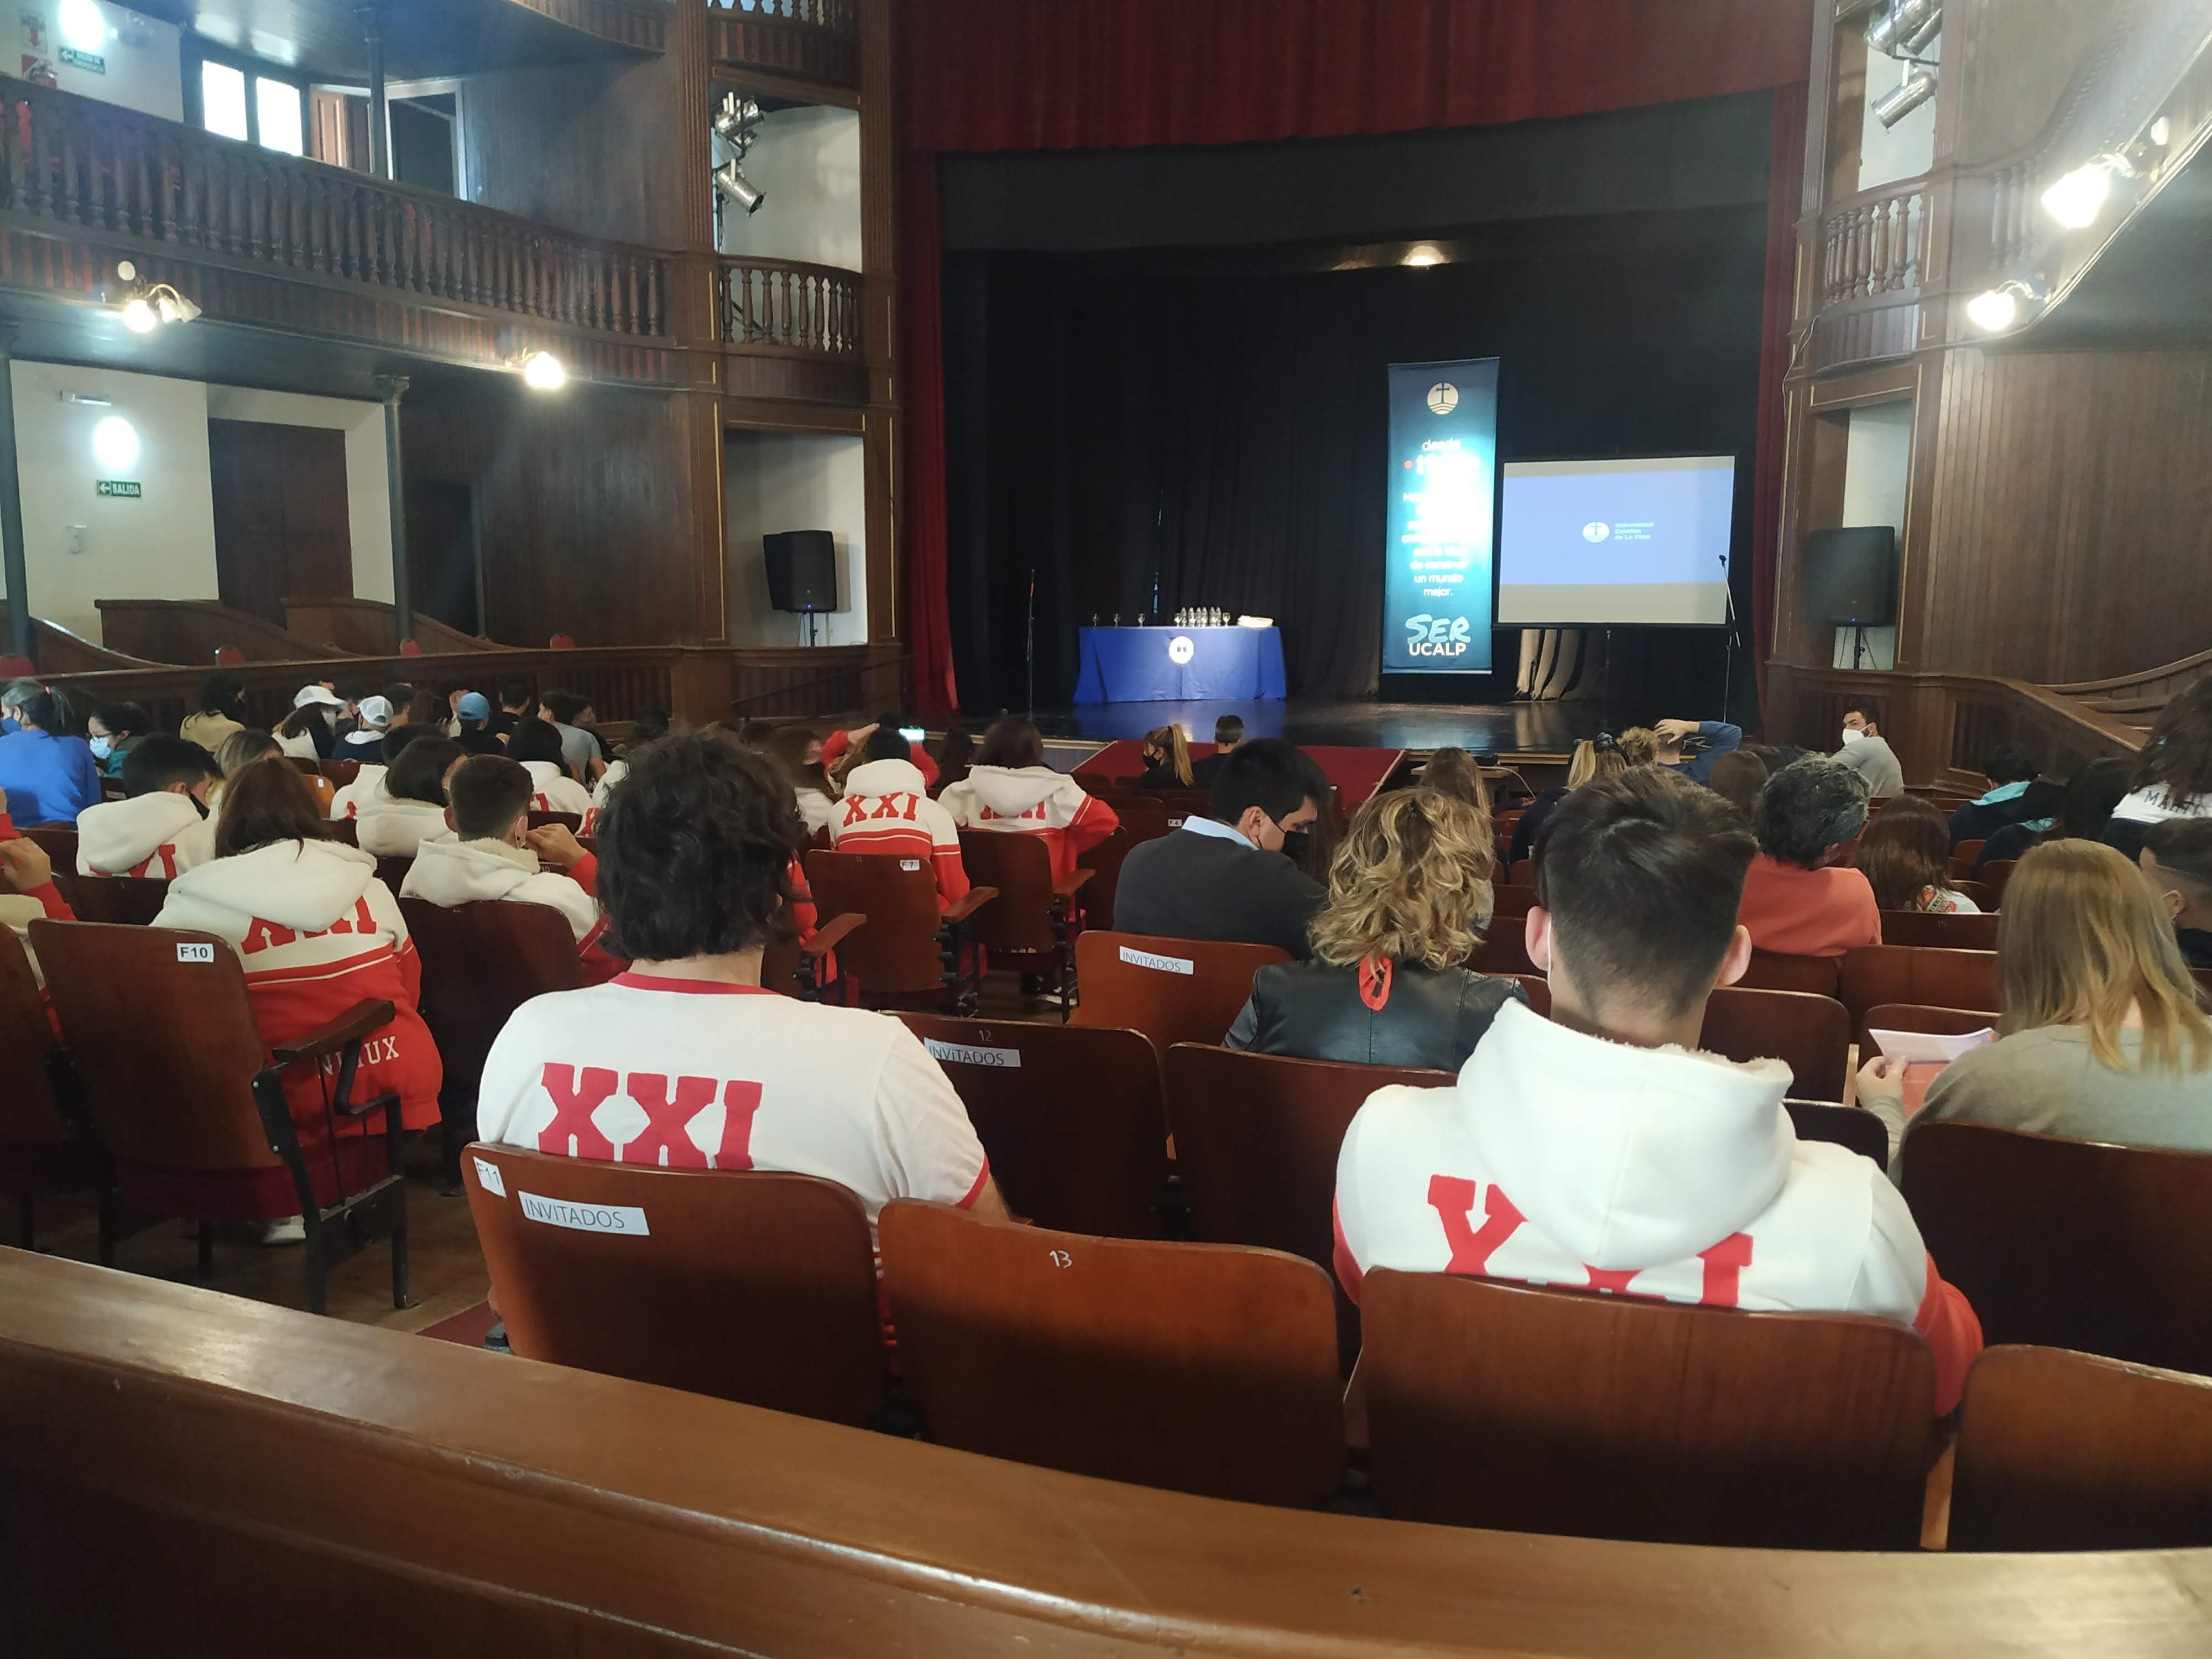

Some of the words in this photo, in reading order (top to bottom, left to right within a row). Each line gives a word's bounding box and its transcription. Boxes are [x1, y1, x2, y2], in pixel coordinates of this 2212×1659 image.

[112, 483, 139, 495] SALIDA
[1428, 573, 1464, 583] mundo
[1423, 587, 1453, 597] mejor.
[1405, 614, 1471, 644] SER
[1409, 642, 1467, 656] UCALP
[843, 791, 920, 828] XXI
[180, 947, 208, 959] F10
[1123, 951, 1181, 972] INVITADOS
[978, 1030, 993, 1041] 12
[929, 1045, 1004, 1066] INVITADOS
[538, 1062, 763, 1170] XXI
[477, 1162, 500, 1186] F11
[525, 1198, 625, 1229] INVITADOS
[1050, 1250, 1072, 1269] 13
